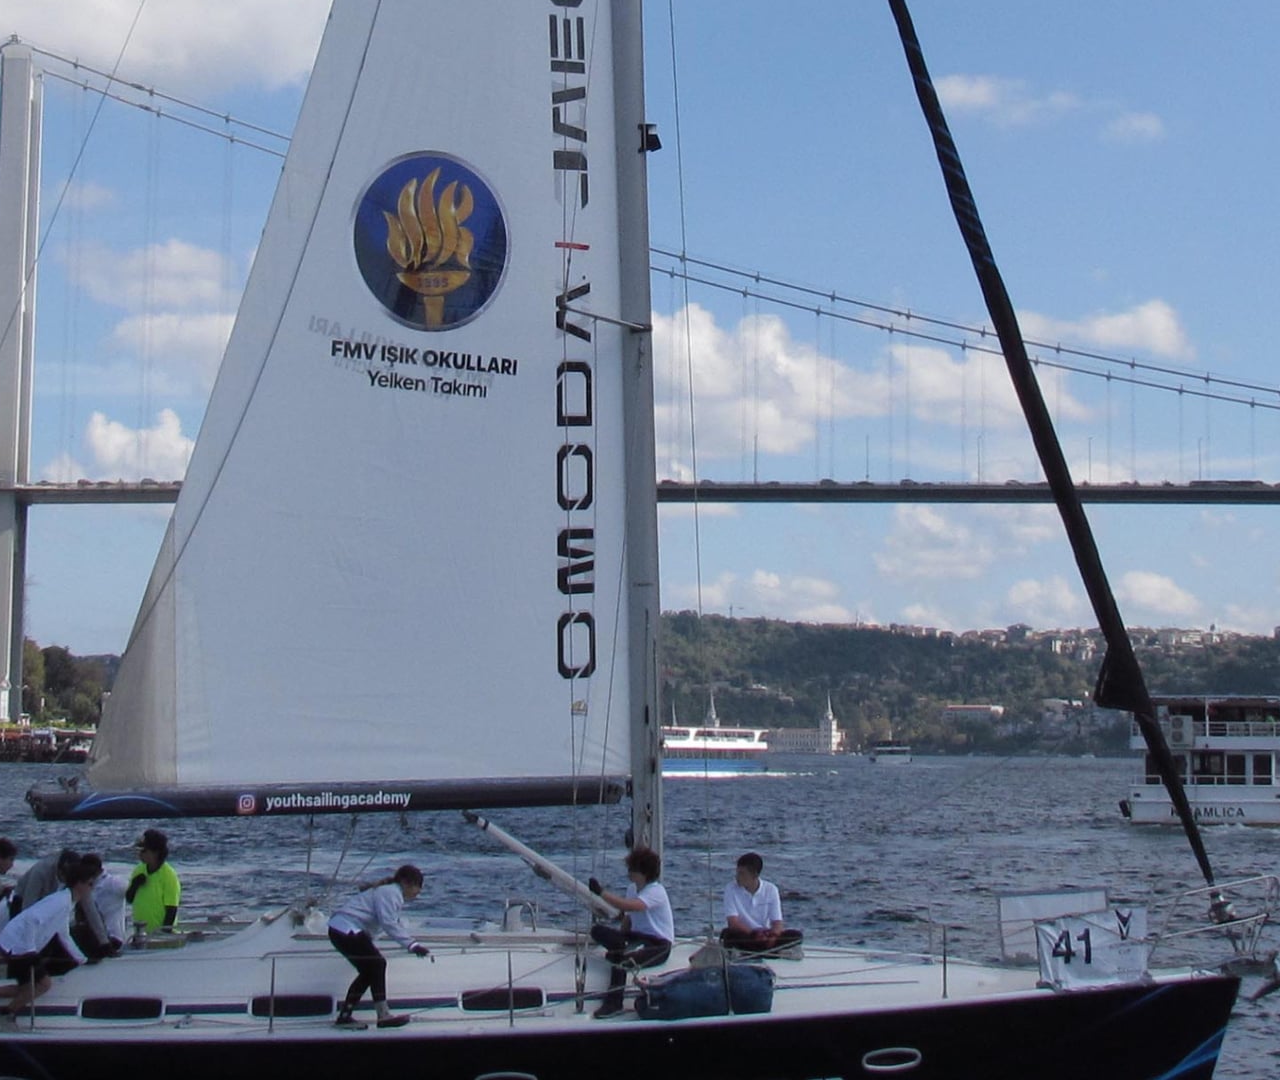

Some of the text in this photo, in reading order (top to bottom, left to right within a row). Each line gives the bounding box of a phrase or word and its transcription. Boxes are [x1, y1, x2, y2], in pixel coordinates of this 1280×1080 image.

[331, 340, 518, 376] FMV IŞIK OKULLARI
[367, 370, 488, 399] Yelken Takımı
[555, 281, 596, 680] OMODA
[265, 791, 412, 811] youthsailingacademy
[1052, 927, 1092, 965] 41
